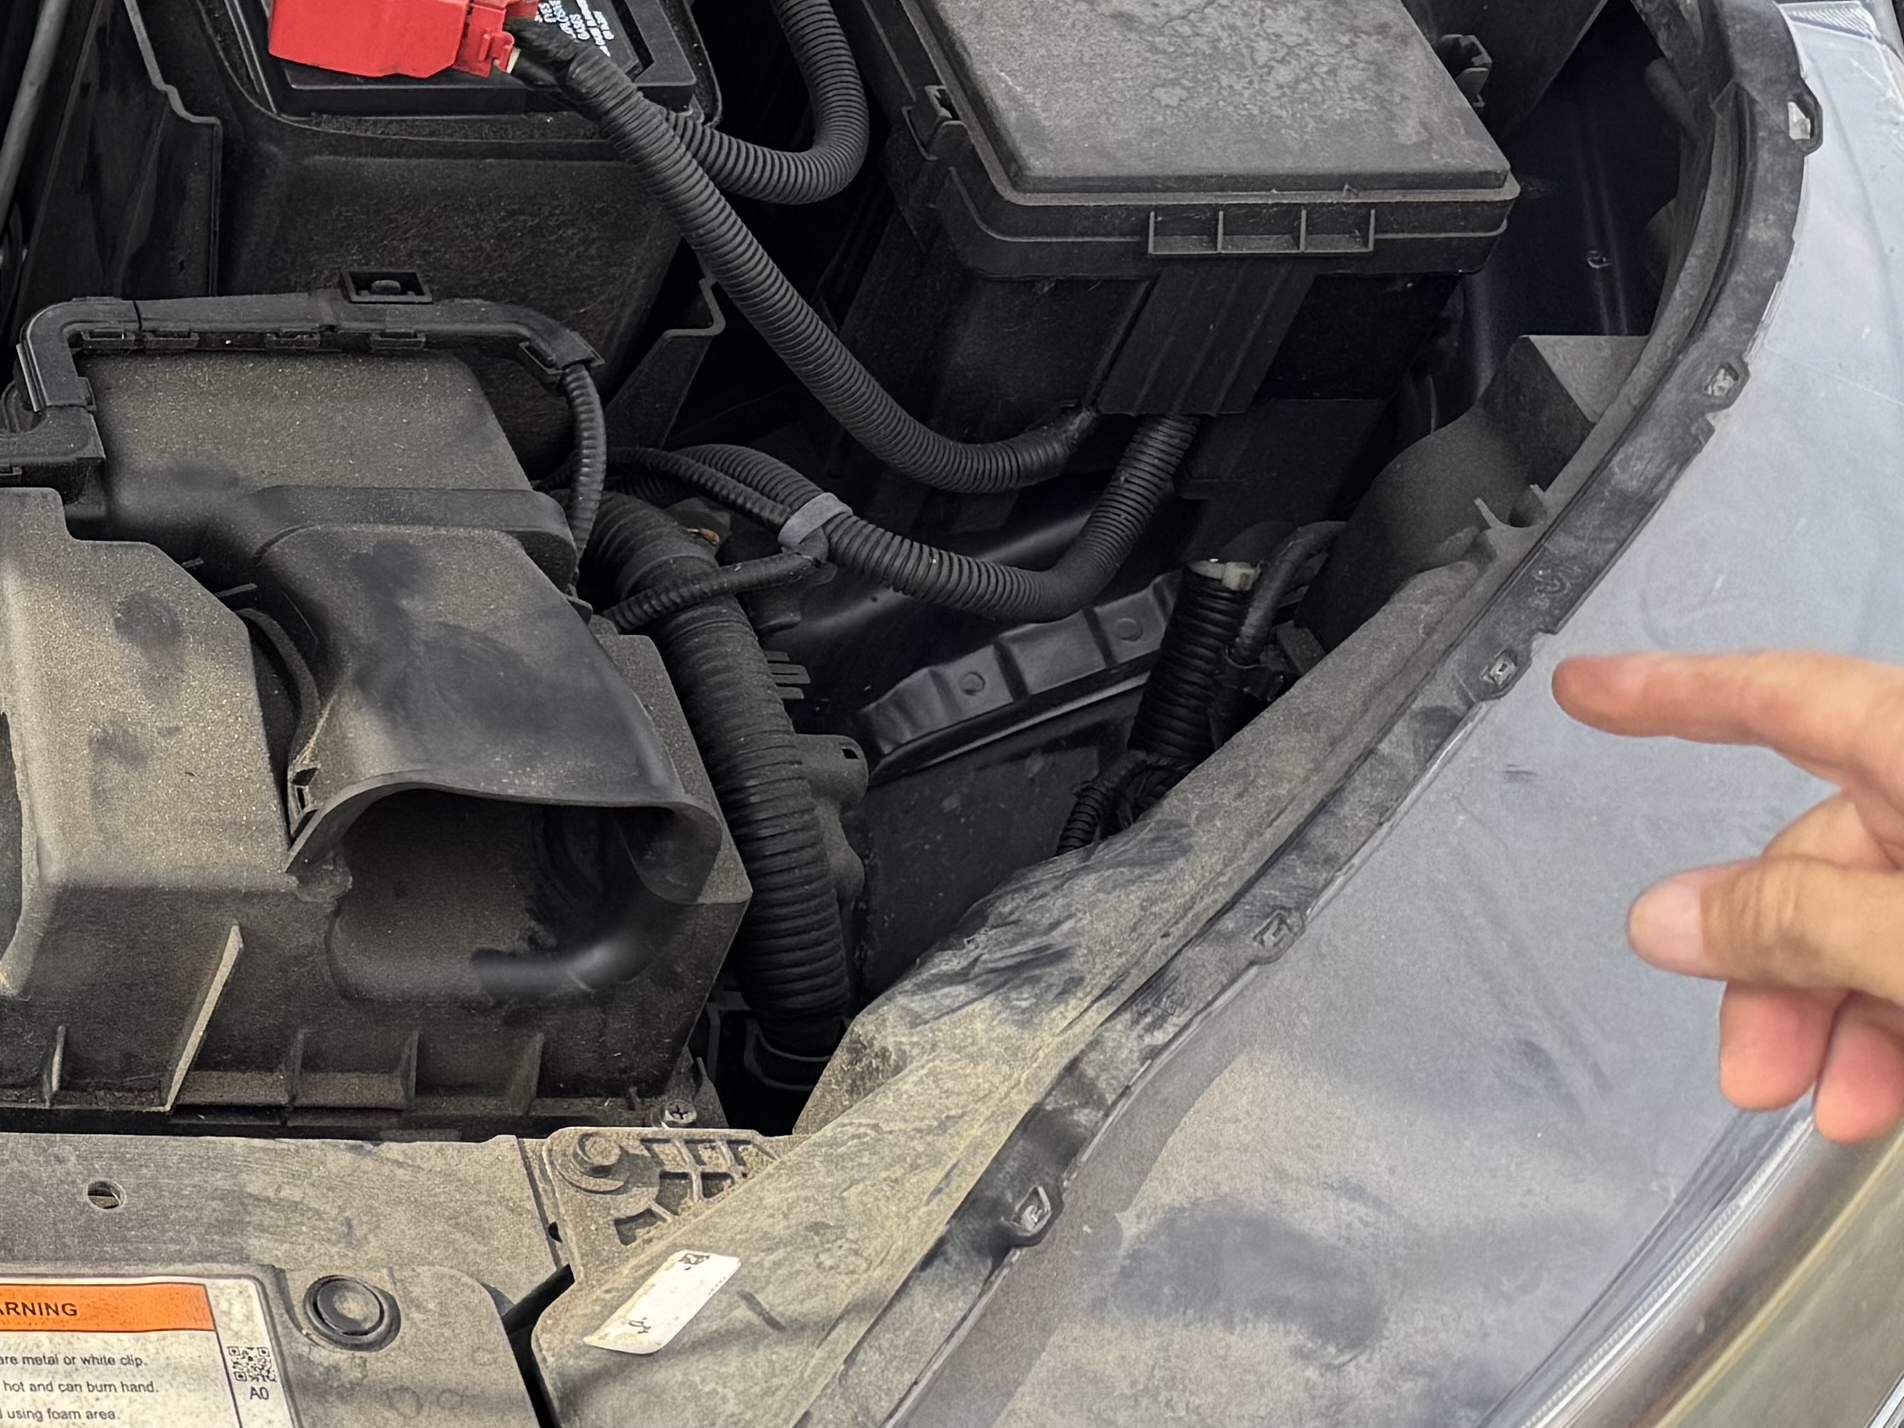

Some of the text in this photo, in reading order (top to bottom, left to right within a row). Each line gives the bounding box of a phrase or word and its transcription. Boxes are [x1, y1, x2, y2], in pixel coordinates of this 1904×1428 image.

[22, 1353, 59, 1366] metal
[63, 1356, 77, 1366] or
[81, 1354, 116, 1366] white
[3, 1380, 25, 1393] hot
[29, 1380, 54, 1393] and
[58, 1383, 83, 1393] can
[86, 1381, 118, 1393] burn
[7, 1408, 44, 1422] using
[47, 1408, 82, 1420] foam
